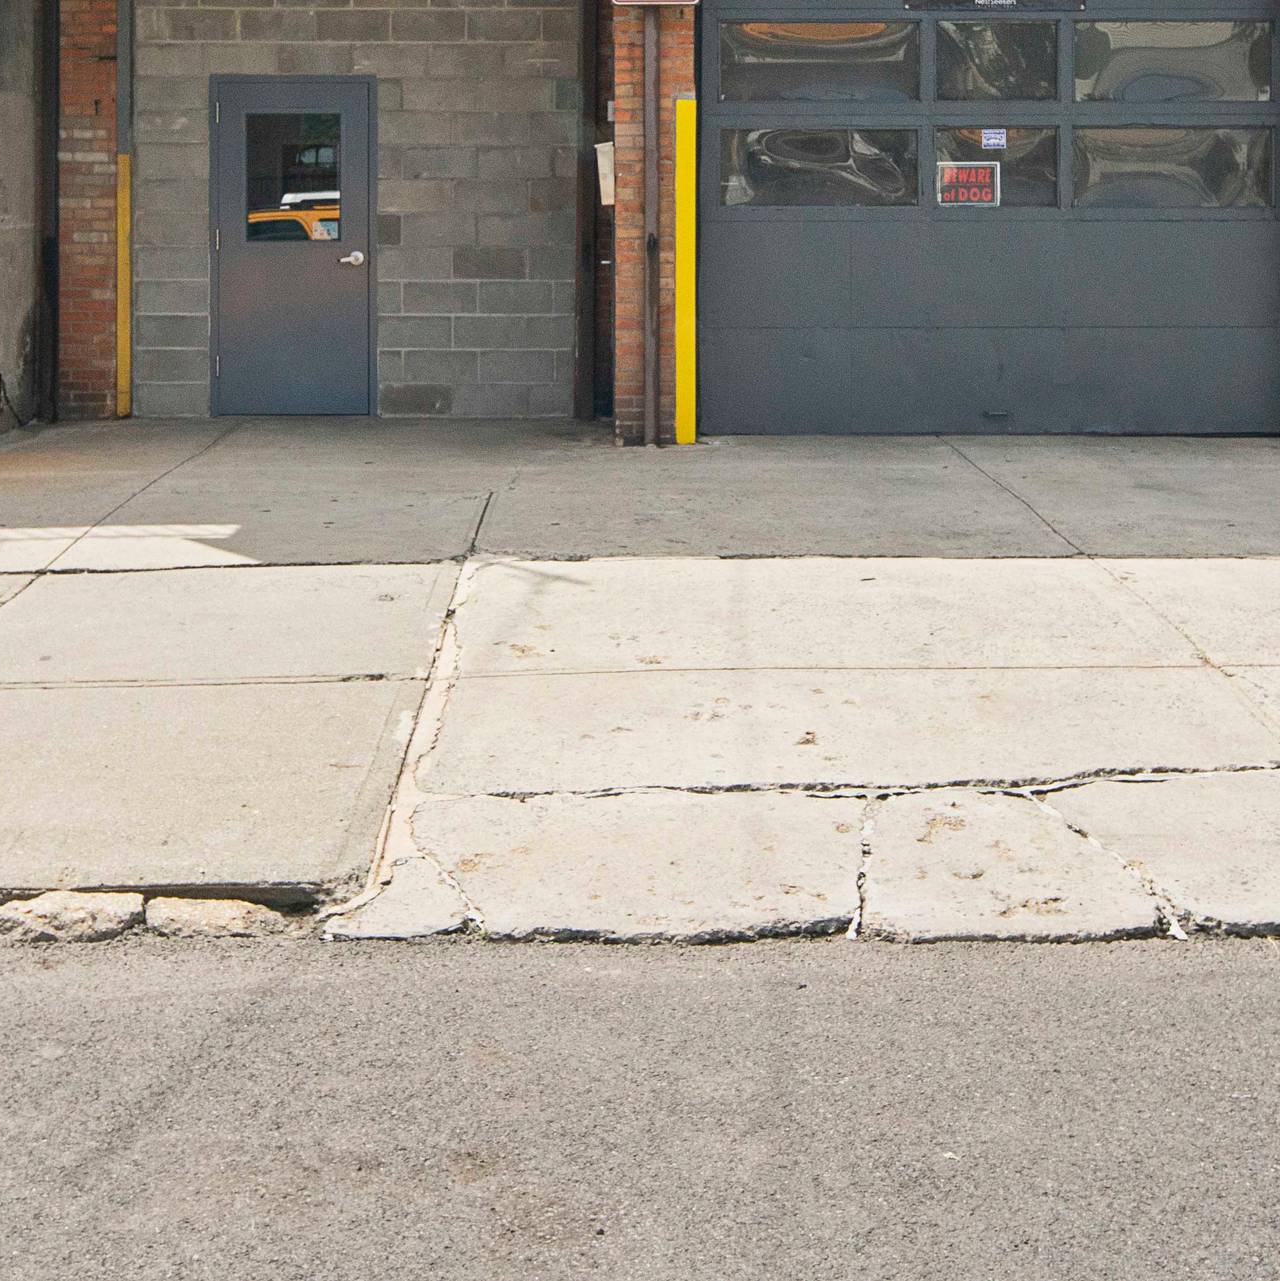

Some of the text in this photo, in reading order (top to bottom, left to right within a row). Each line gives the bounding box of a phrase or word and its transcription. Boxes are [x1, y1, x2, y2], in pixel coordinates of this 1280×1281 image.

[943, 167, 991, 183] BEWARE
[943, 187, 993, 202] of DOG
